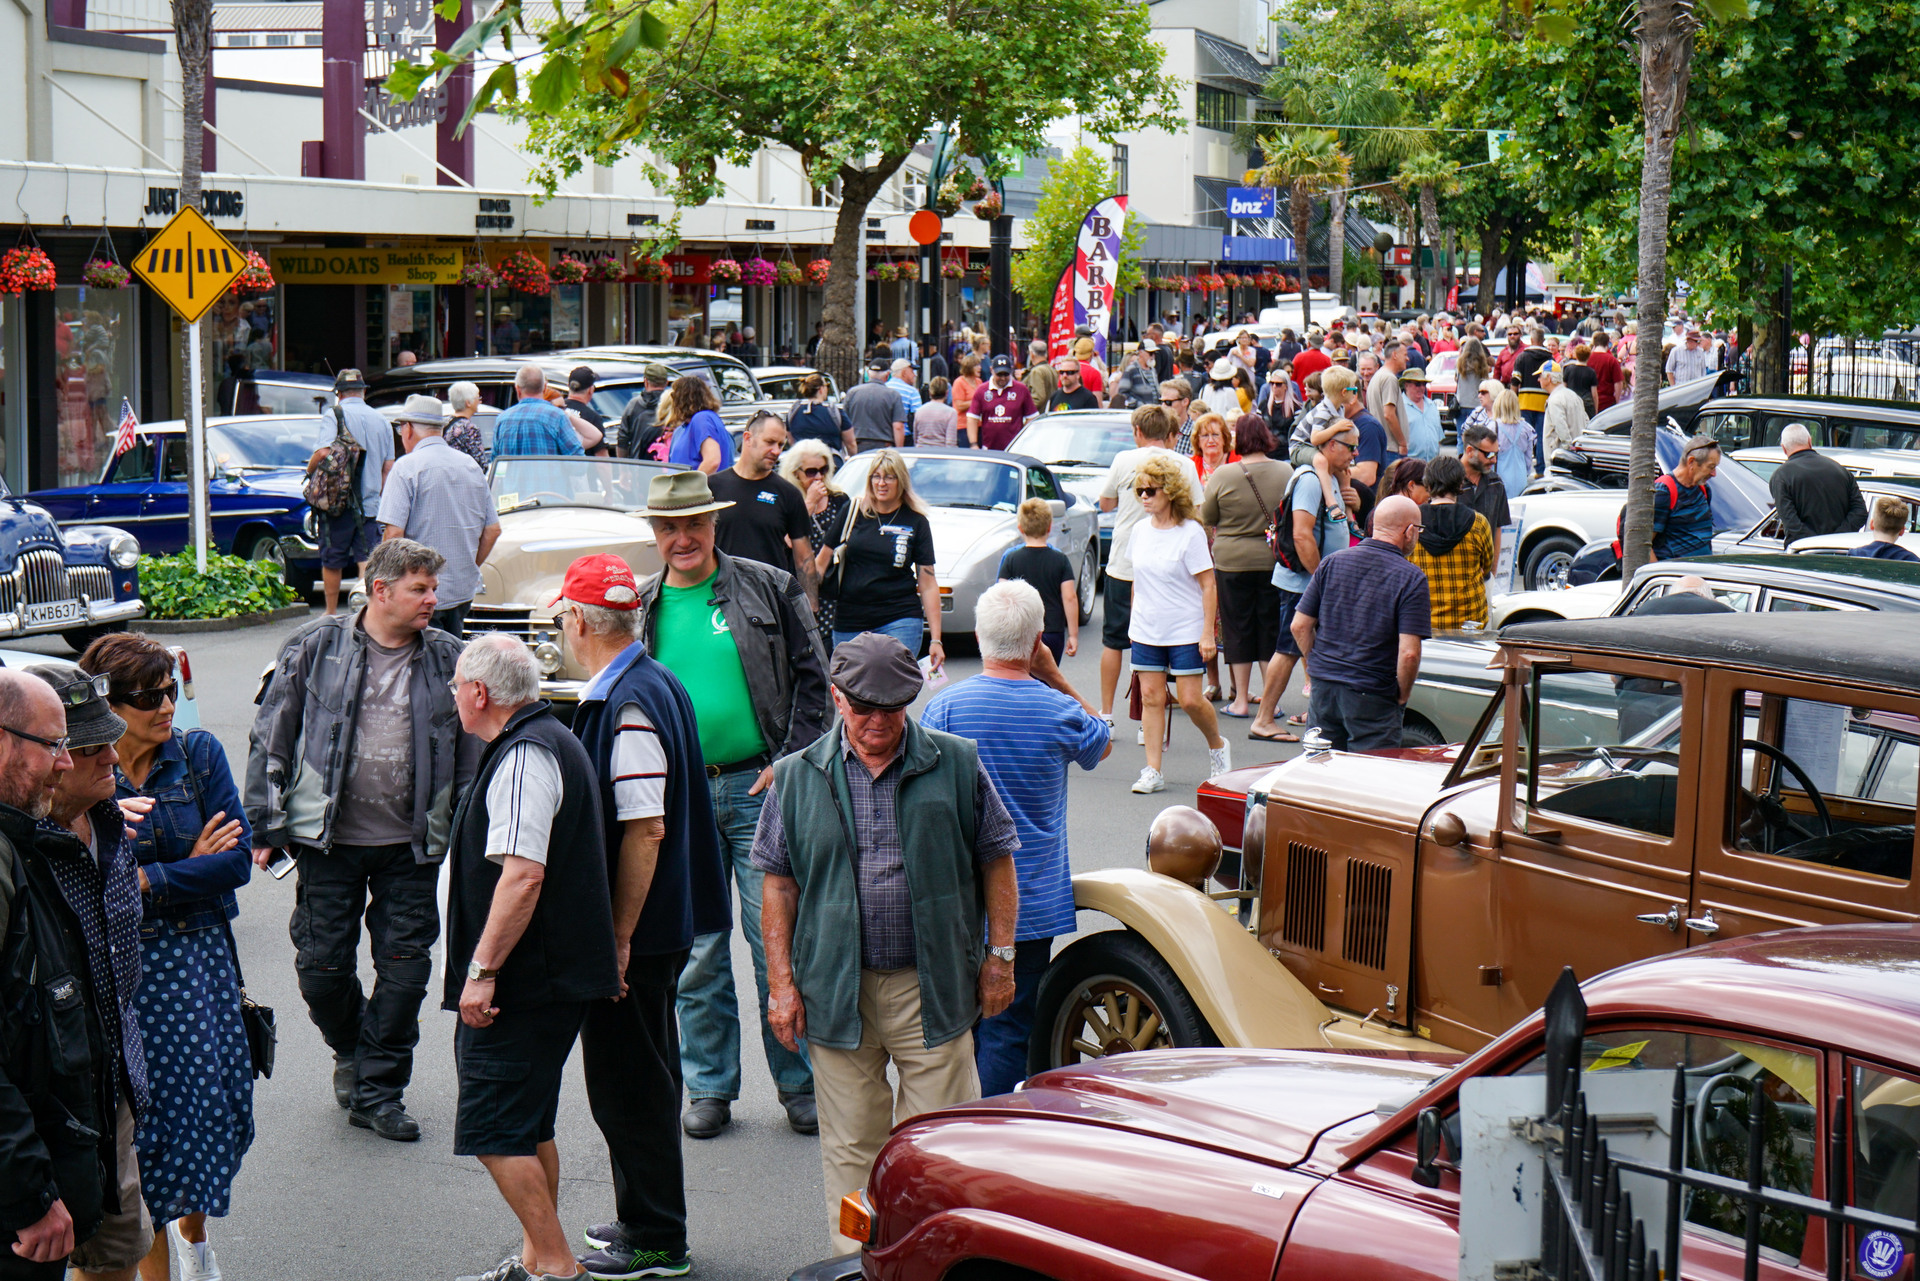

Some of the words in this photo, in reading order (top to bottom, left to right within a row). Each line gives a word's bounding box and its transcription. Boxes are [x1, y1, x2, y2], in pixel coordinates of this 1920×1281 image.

[144, 187, 178, 215] JUST
[181, 189, 243, 217] OKING
[1230, 198, 1263, 214] bnz
[278, 256, 326, 275] WILD
[329, 256, 380, 275] OATS
[387, 253, 426, 266] Health
[428, 253, 456, 266] Food
[407, 268, 437, 282] Shop
[1087, 216, 1112, 335] BARBE
[31, 603, 76, 621] KWB637
